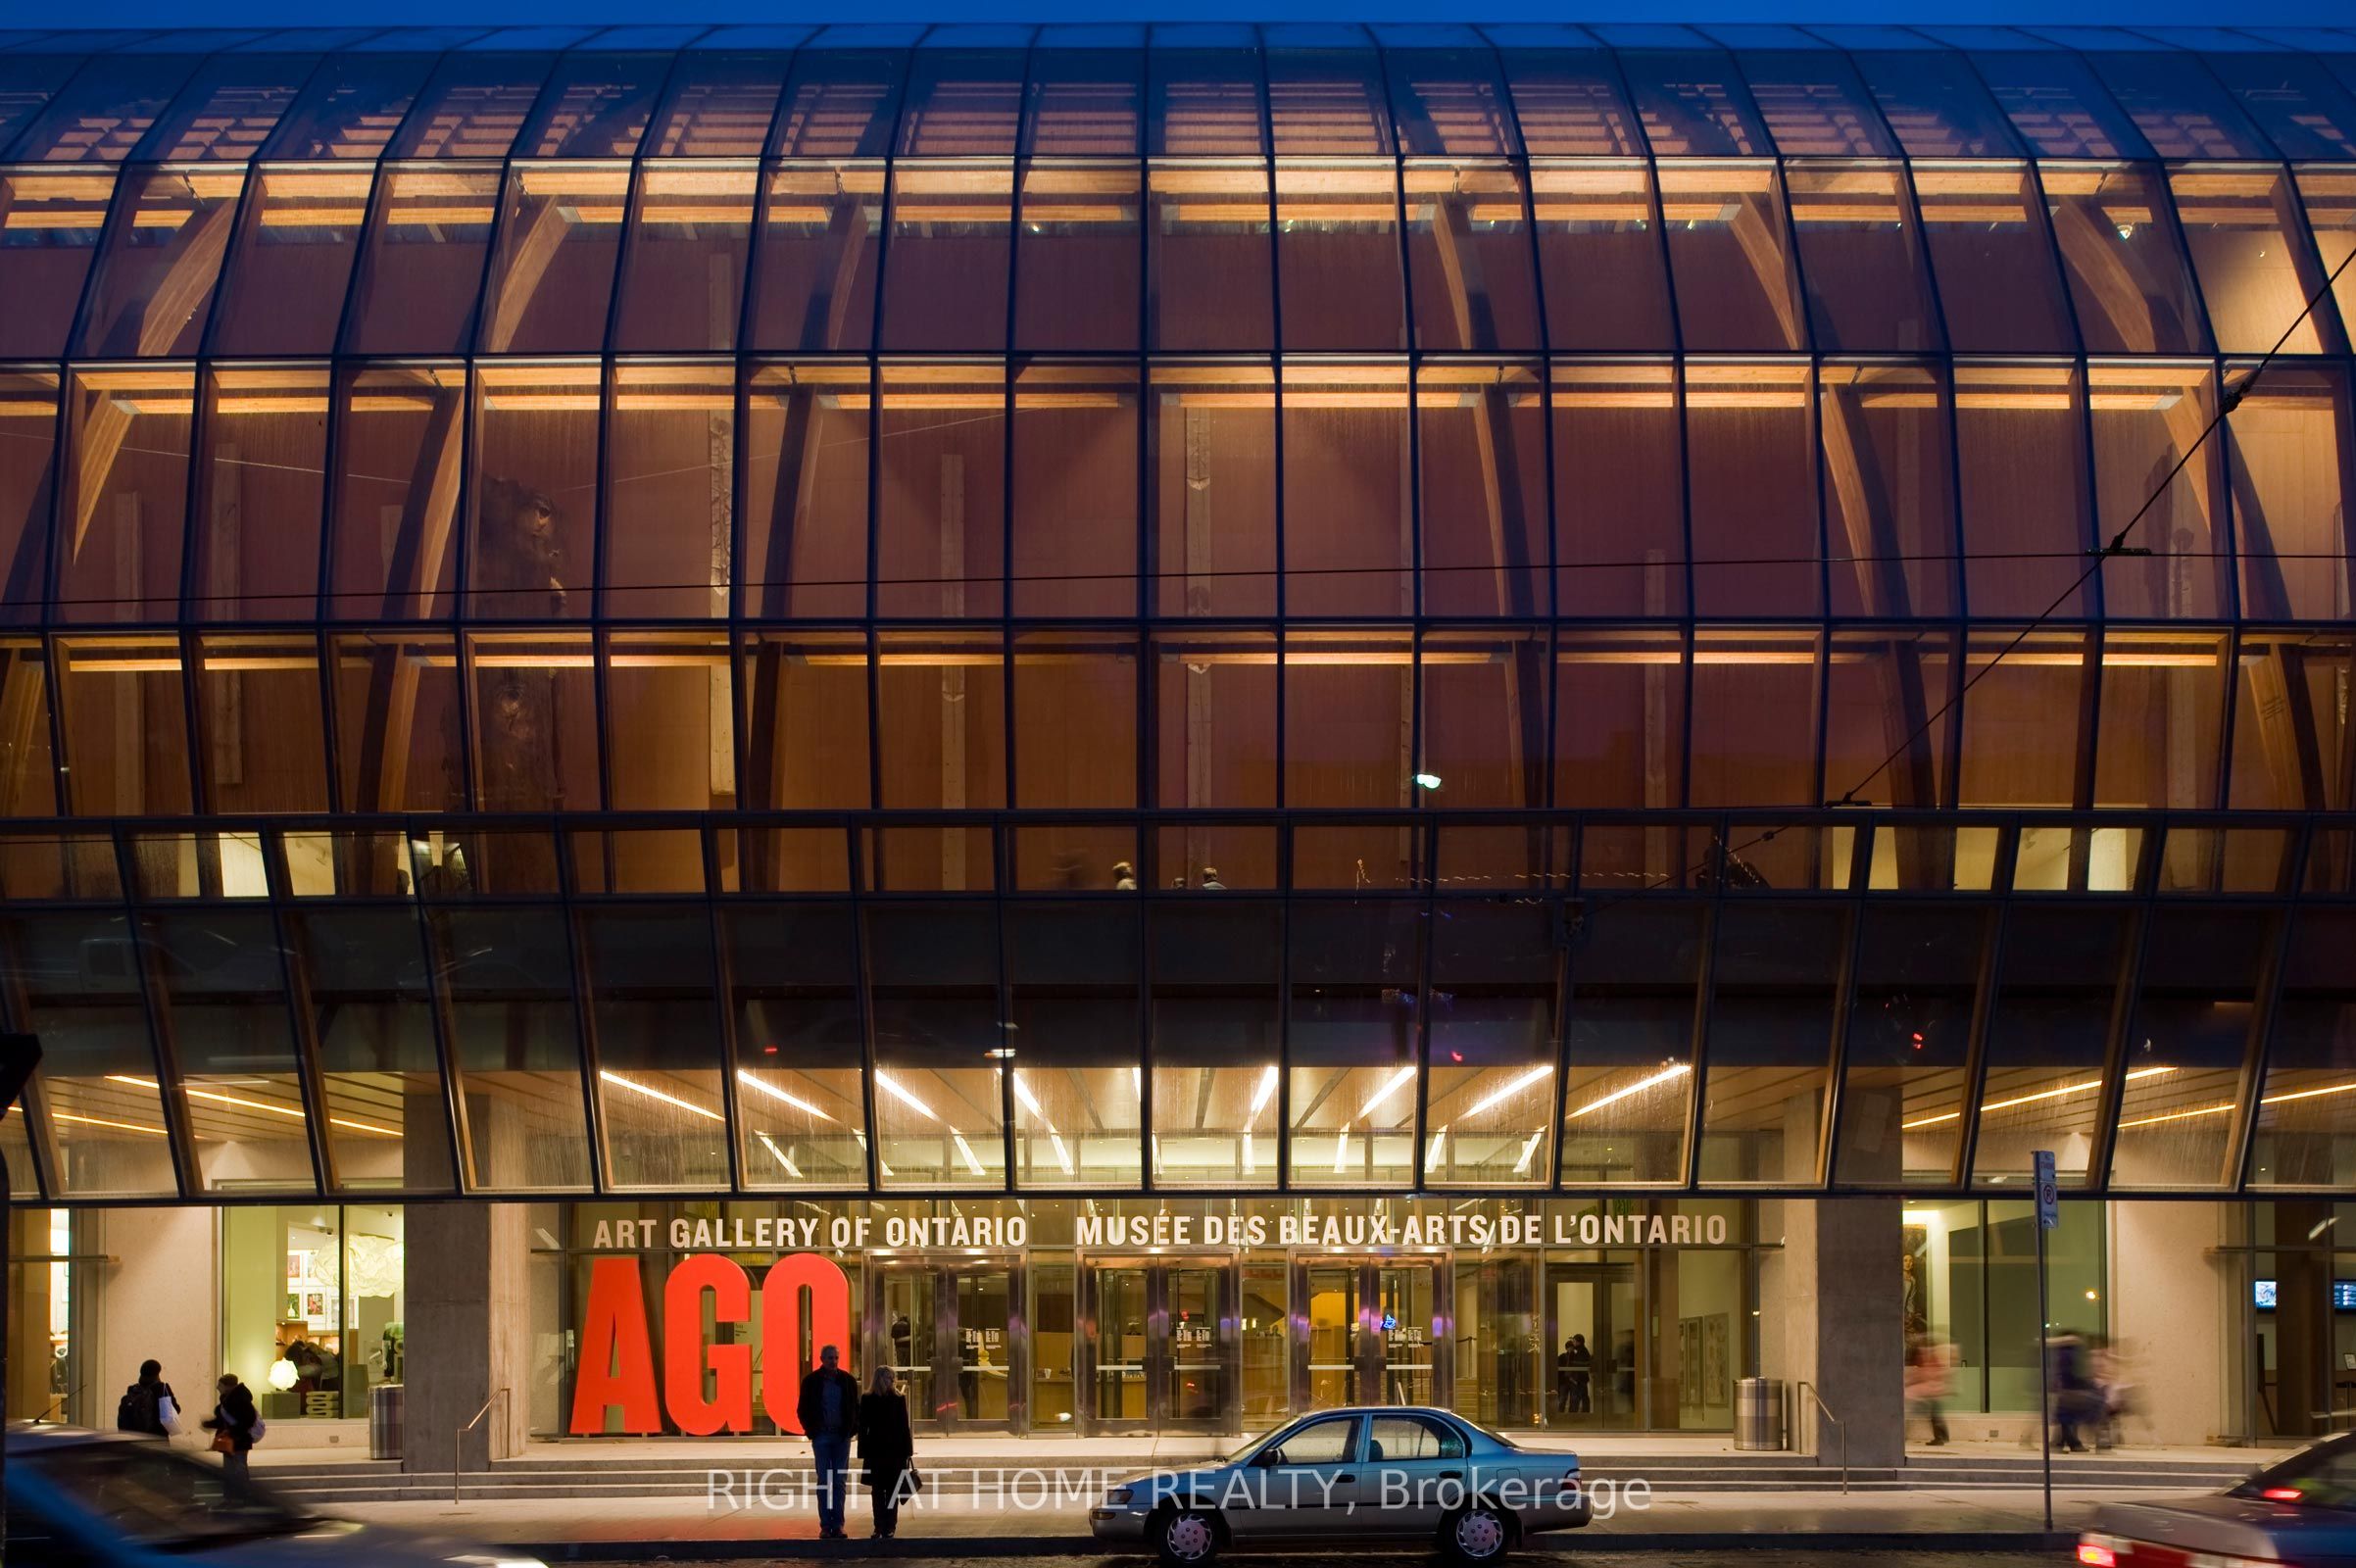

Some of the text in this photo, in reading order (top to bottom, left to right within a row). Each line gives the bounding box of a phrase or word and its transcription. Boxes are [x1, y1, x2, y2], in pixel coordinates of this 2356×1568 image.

[593, 1217, 1027, 1248] ART GALLERY OF ONTARIO
[1076, 1208, 1727, 1245] MUSÉE DES BEAUX-ARTS DE L'ONTARIO
[569, 1252, 850, 1436] AGO
